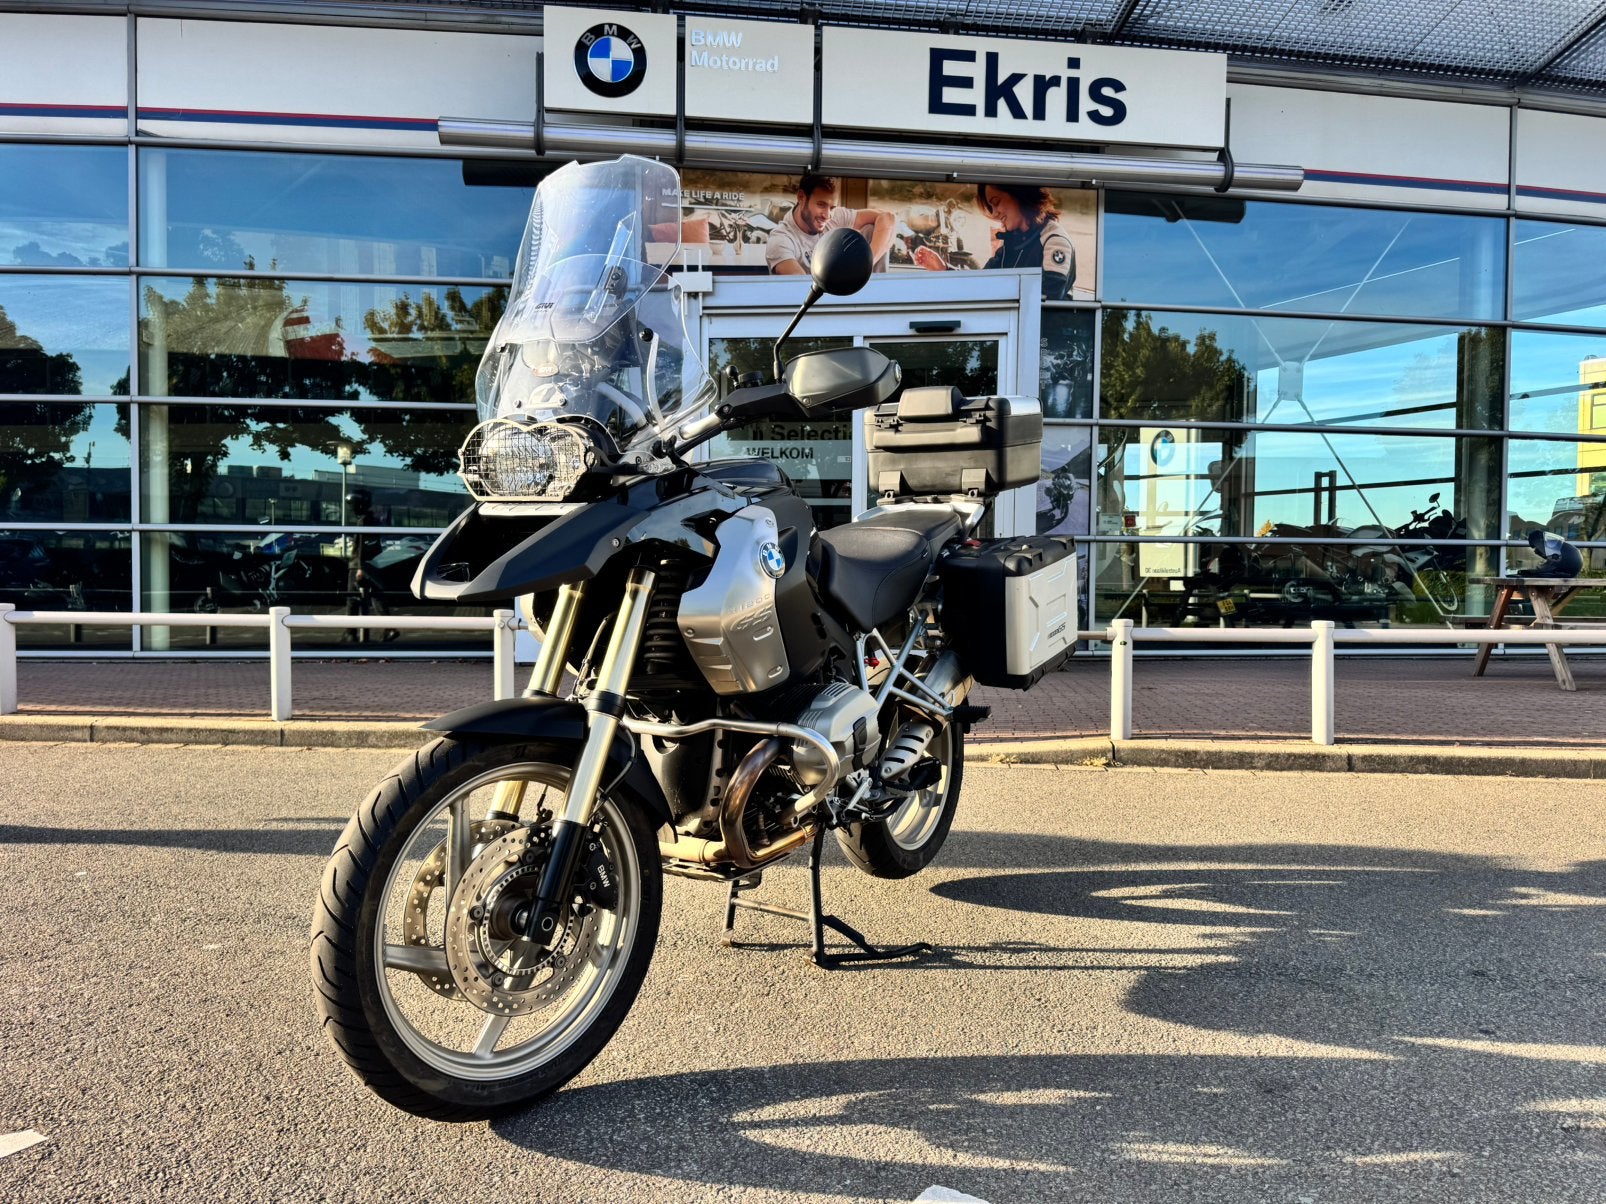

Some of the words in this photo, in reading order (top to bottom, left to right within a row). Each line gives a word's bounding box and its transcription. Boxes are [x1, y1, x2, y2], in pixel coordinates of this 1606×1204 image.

[581, 24, 642, 49] BMW
[691, 29, 743, 49] BMW
[691, 49, 779, 73] Motorrad
[928, 47, 1127, 127] Ekris
[692, 189, 711, 199] LIFE
[713, 191, 721, 200] A
[722, 191, 745, 201] RIDE
[771, 424, 852, 441] Selecti
[746, 447, 814, 460] WELKOM
[597, 864, 611, 888] BMW
